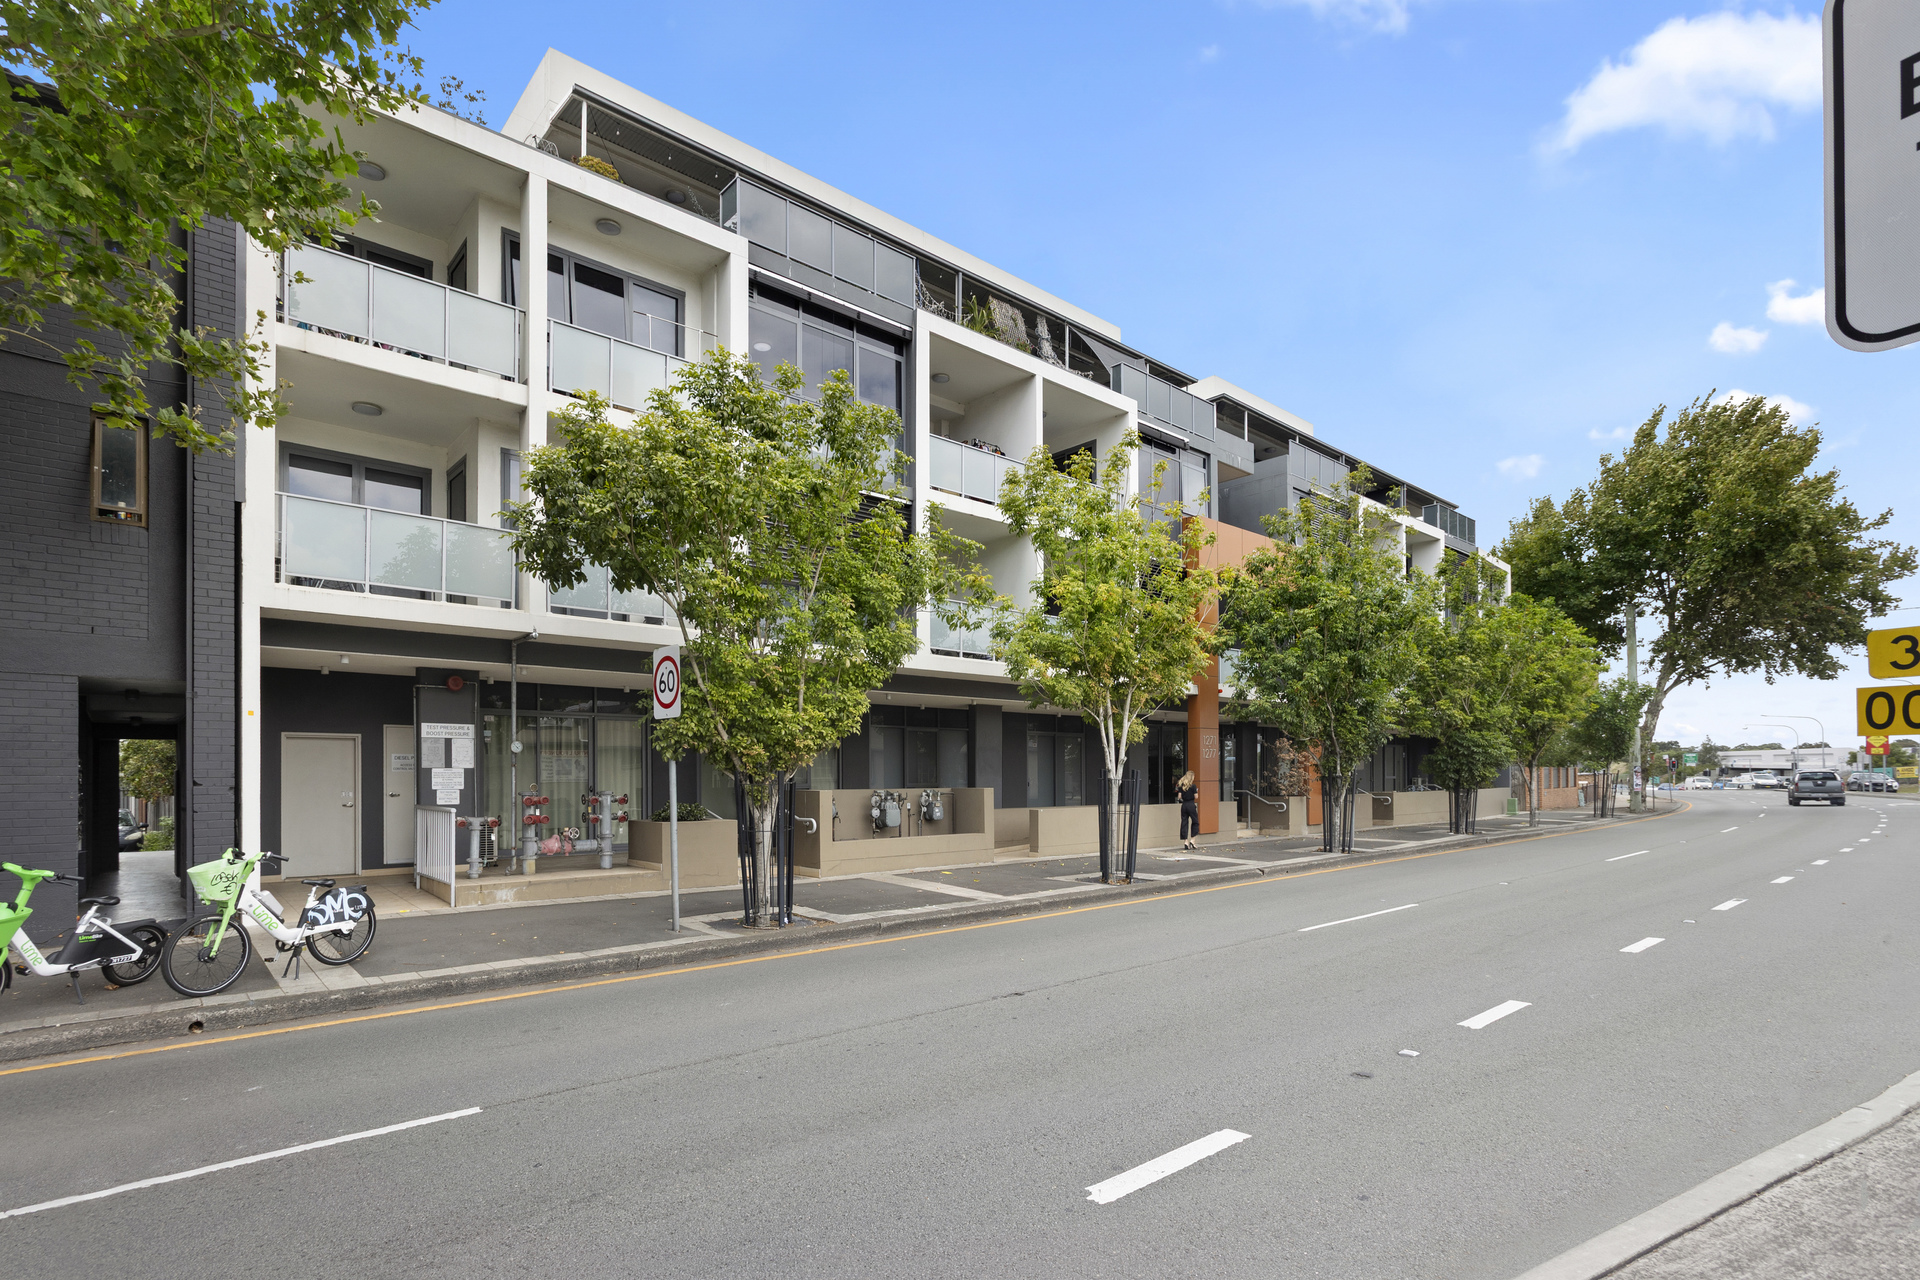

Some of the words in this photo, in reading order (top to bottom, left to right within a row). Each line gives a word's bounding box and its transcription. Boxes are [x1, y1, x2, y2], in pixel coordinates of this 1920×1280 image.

[659, 670, 675, 693] 60
[1203, 735, 1216, 745] 1271
[1202, 748, 1216, 758] 1277
